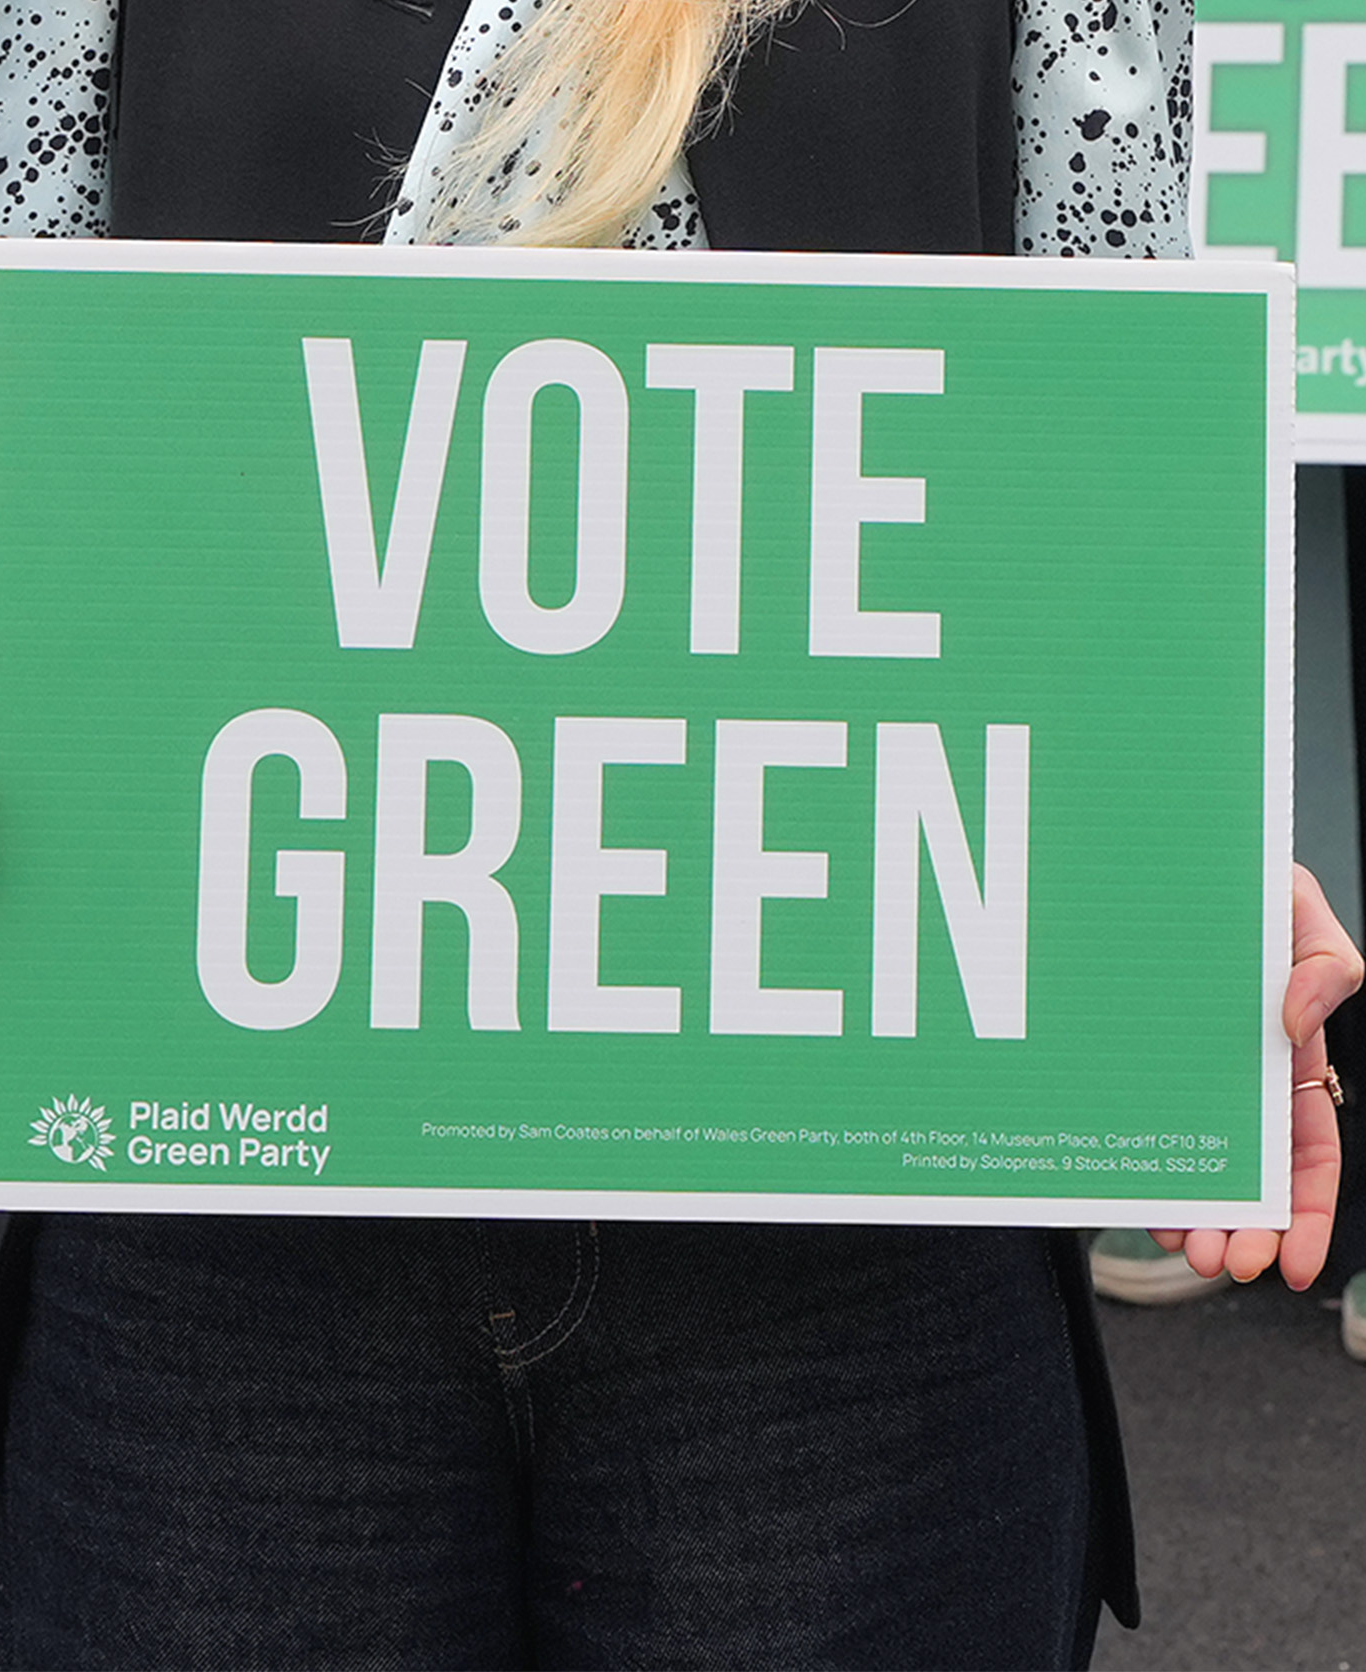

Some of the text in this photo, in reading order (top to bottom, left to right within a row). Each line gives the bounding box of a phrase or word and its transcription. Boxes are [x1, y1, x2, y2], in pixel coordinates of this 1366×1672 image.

[301, 337, 946, 659] VOTE
[195, 708, 1030, 1041] GREEN
[130, 1101, 328, 1133] Plaid Werdd
[422, 1122, 495, 1138] Promoted
[498, 1124, 516, 1141] by
[518, 1123, 552, 1139] Sam
[554, 1124, 609, 1140] Coates
[611, 1128, 631, 1140] on
[634, 1127, 682, 1141] behalf
[684, 1127, 700, 1141] of
[702, 1128, 748, 1142] Wales
[750, 1127, 796, 1143] Green
[799, 1128, 840, 1146] Party,
[843, 1130, 879, 1144] both
[882, 1130, 897, 1145] of
[900, 1131, 926, 1145] 4th
[929, 1131, 968, 1146] Floor,
[972, 1131, 987, 1145] 14
[990, 1132, 1055, 1147] Museum
[1058, 1132, 1101, 1148] Place,
[1104, 1133, 1157, 1149] Cardiff
[1158, 1134, 1195, 1150] CF10
[127, 1136, 331, 1175] Green Party
[902, 1153, 957, 1169] Printed
[959, 1155, 978, 1172] by
[1061, 1156, 1072, 1171] 9
[1075, 1156, 1118, 1171] Stock
[1166, 1157, 1196, 1172] SS2
